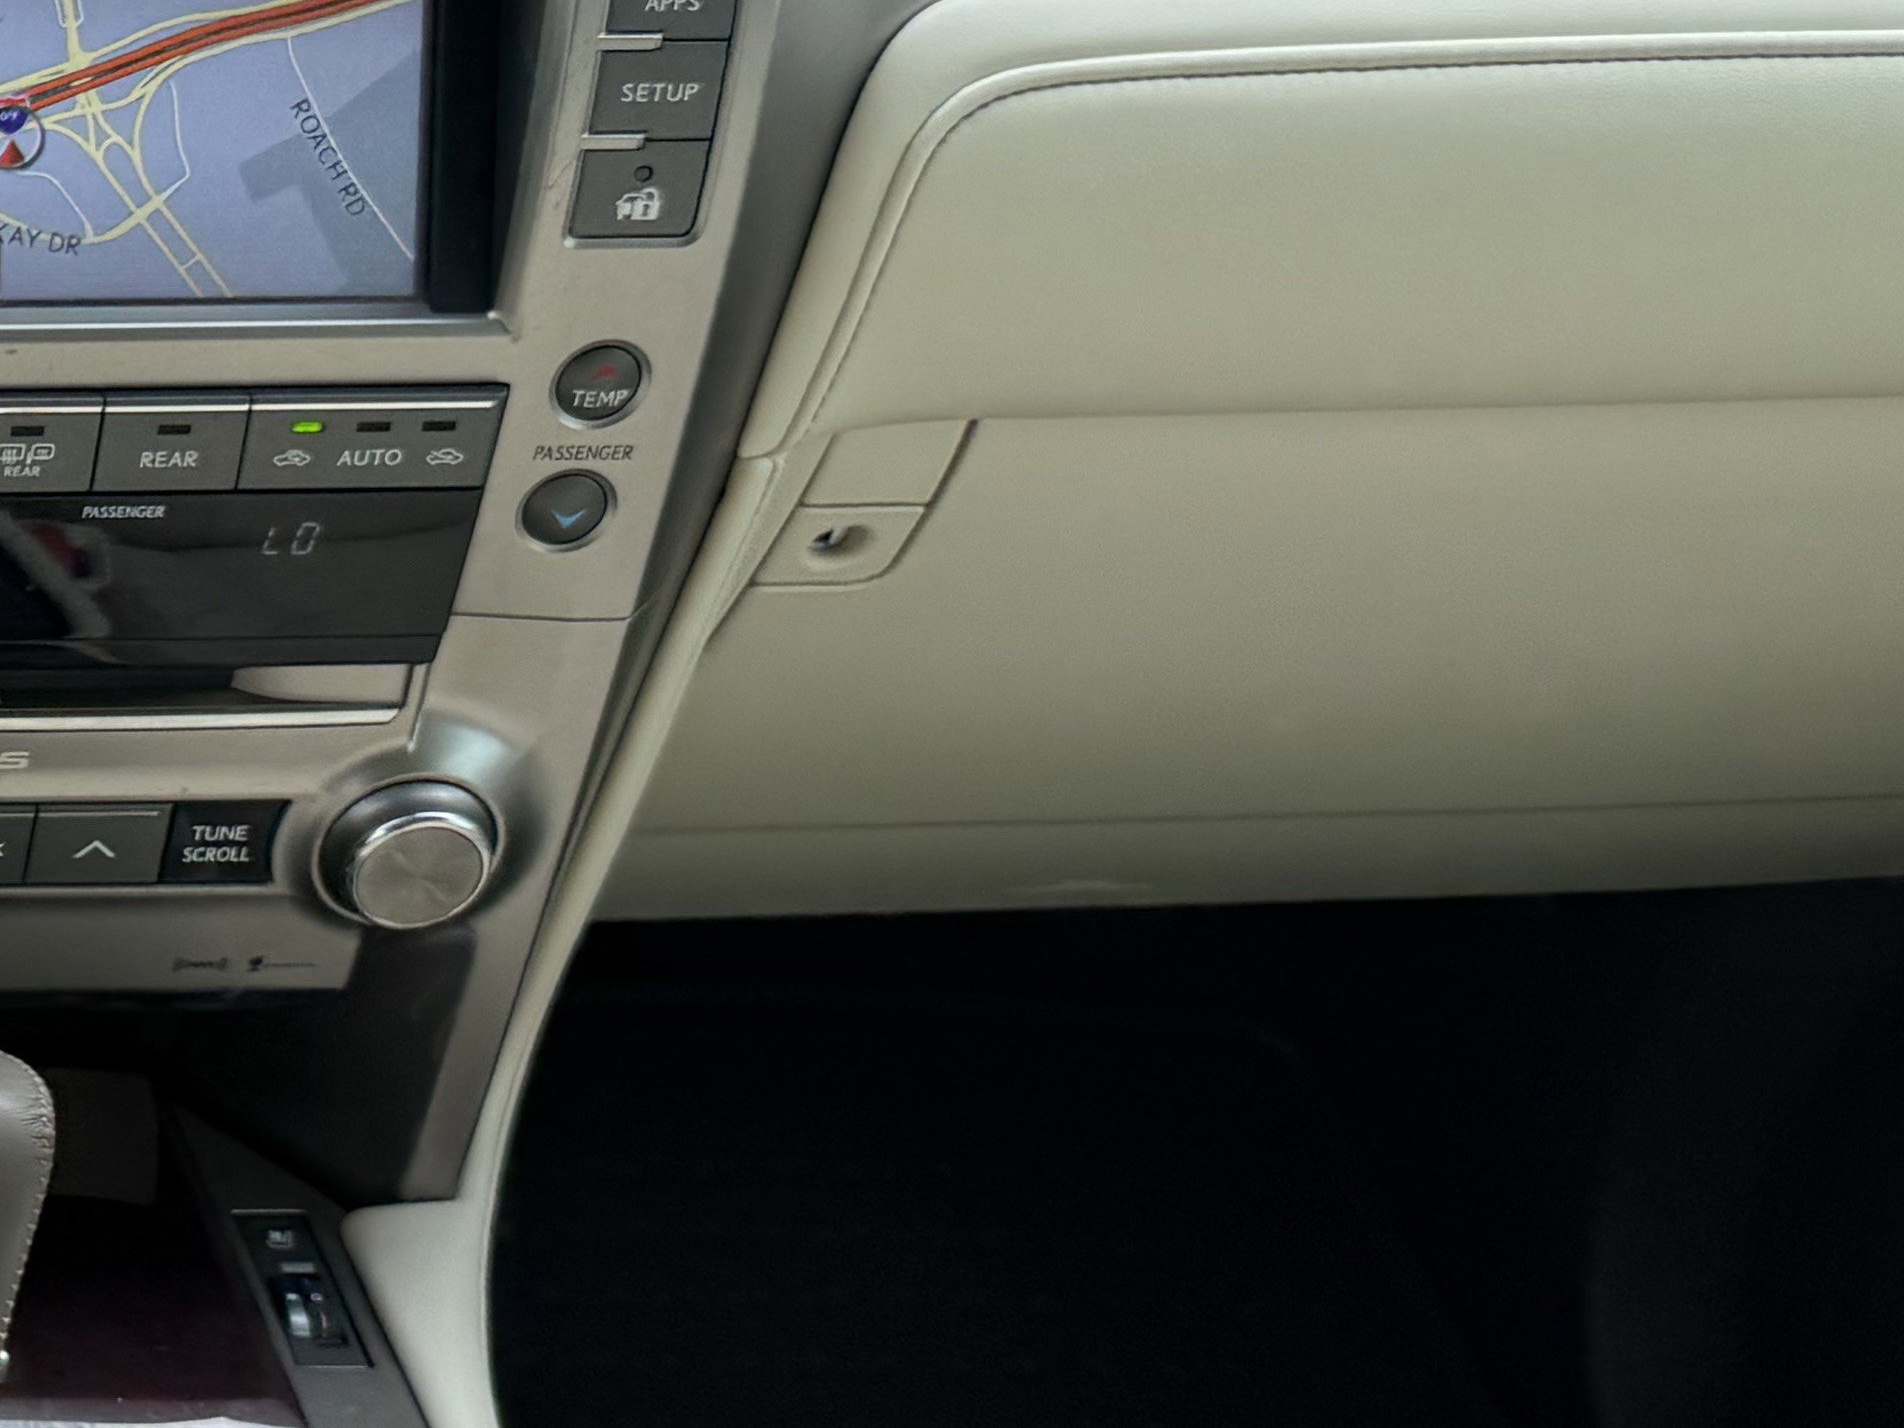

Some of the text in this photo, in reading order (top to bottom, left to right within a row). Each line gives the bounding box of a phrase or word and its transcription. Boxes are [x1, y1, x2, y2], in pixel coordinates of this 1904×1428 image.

[620, 83, 700, 102] SETUP
[289, 97, 367, 217] ROACH RD
[49, 230, 81, 256] DR
[571, 389, 630, 409] TEMP
[139, 449, 198, 468] REAR
[336, 448, 402, 467] AUTO
[531, 443, 634, 463] PASSENGER
[2, 466, 41, 478] REAR
[81, 504, 166, 519] PASSENGER
[191, 824, 250, 842] TUNE
[181, 845, 251, 863] SCROLL
